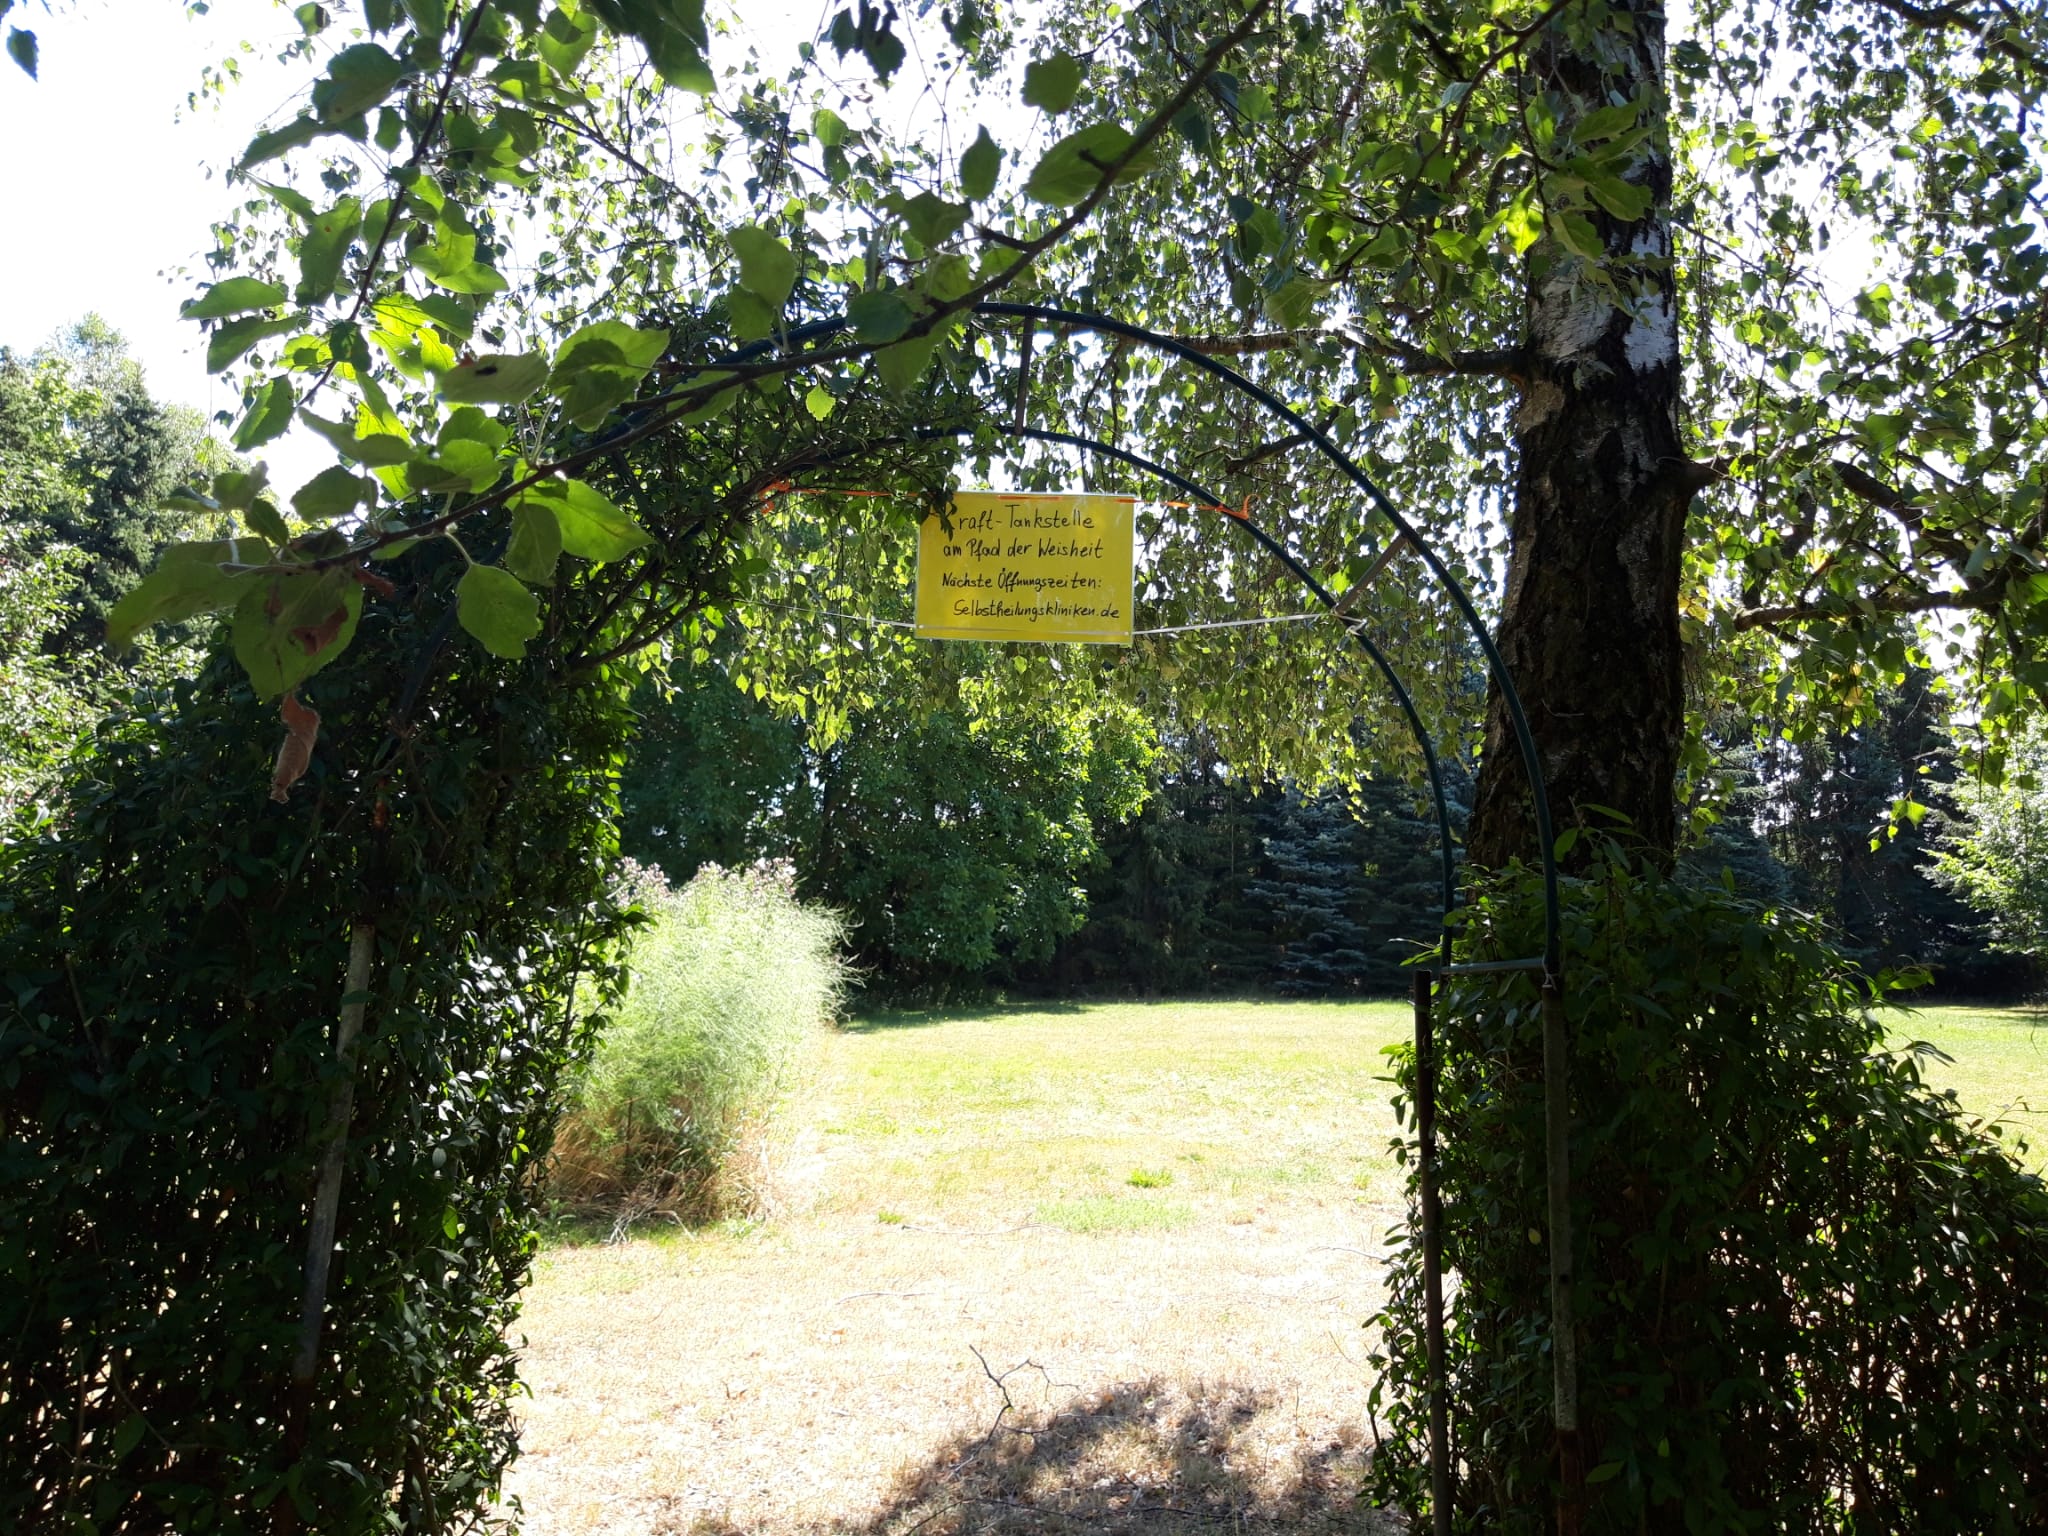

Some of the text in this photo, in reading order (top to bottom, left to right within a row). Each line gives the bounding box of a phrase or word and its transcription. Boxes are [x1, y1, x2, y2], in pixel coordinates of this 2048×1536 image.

[943, 537, 1105, 562] am Pfad der Weisheit
[997, 567, 1102, 593] Öffnungszeiten:
[953, 598, 1120, 622] Selbstheilungskliniken.de
